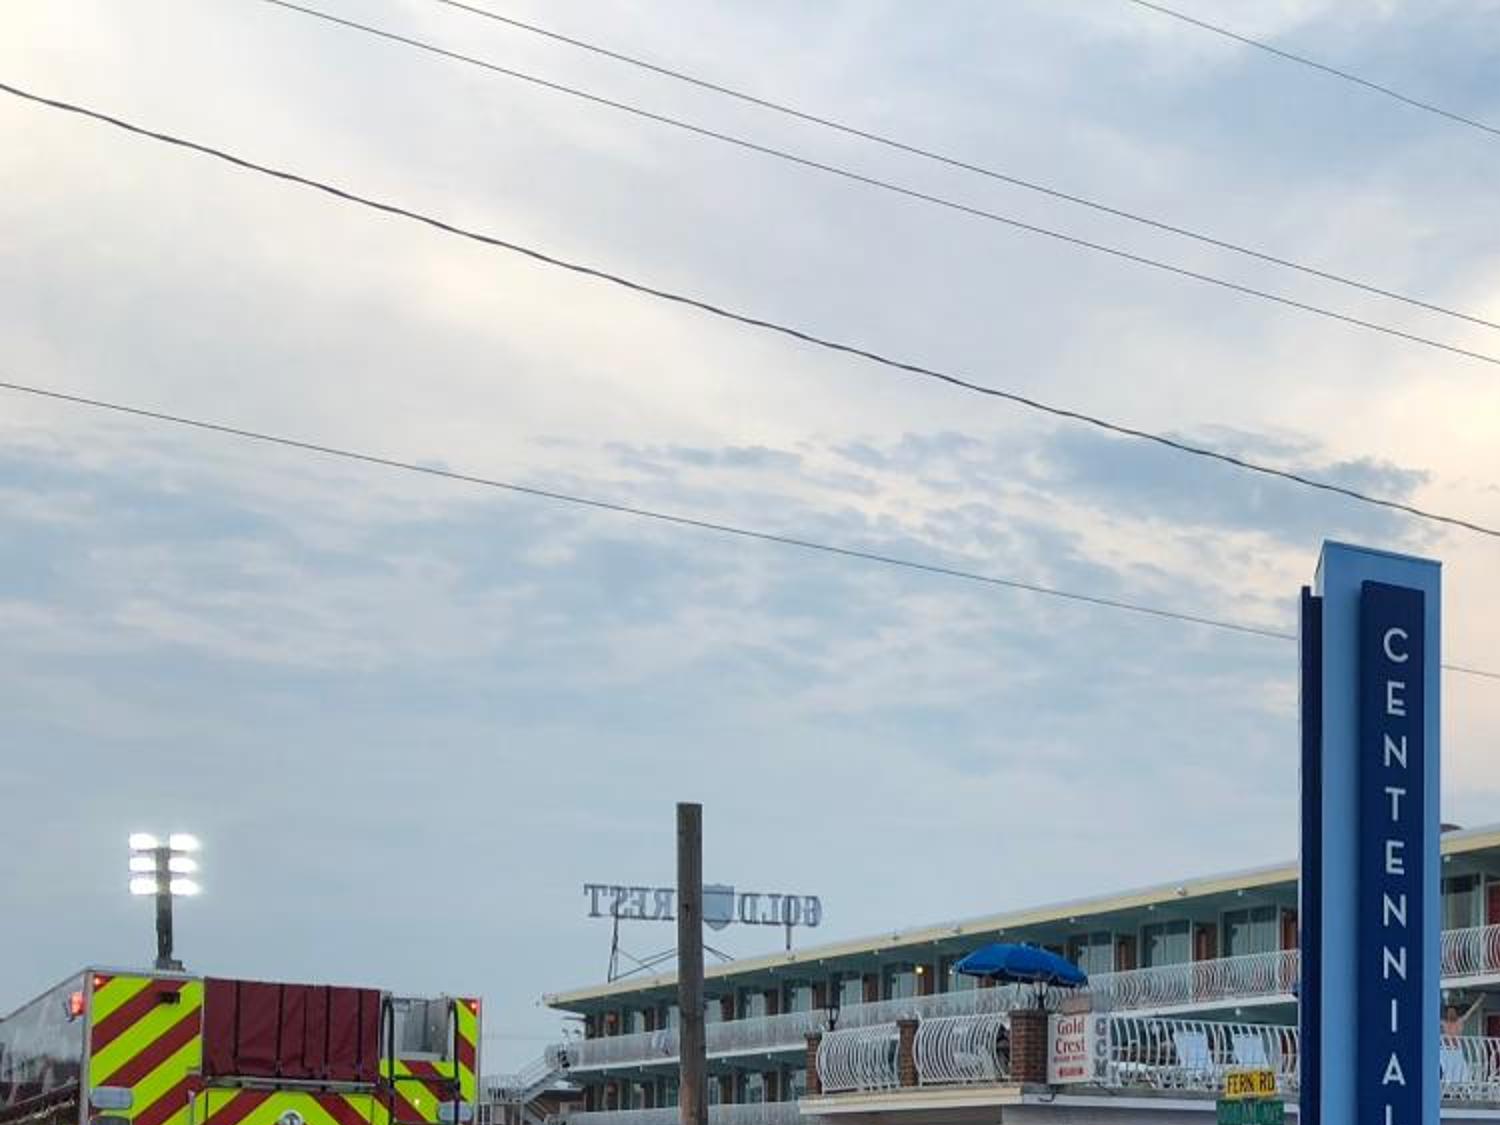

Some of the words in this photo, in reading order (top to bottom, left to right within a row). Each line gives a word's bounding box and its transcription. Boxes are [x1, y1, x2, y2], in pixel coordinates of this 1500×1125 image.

[1056, 1016, 1086, 1035] Gold
[1055, 1037, 1087, 1055] Crest
[1227, 1073, 1255, 1094] FERN
[1259, 1071, 1275, 1092] RD
